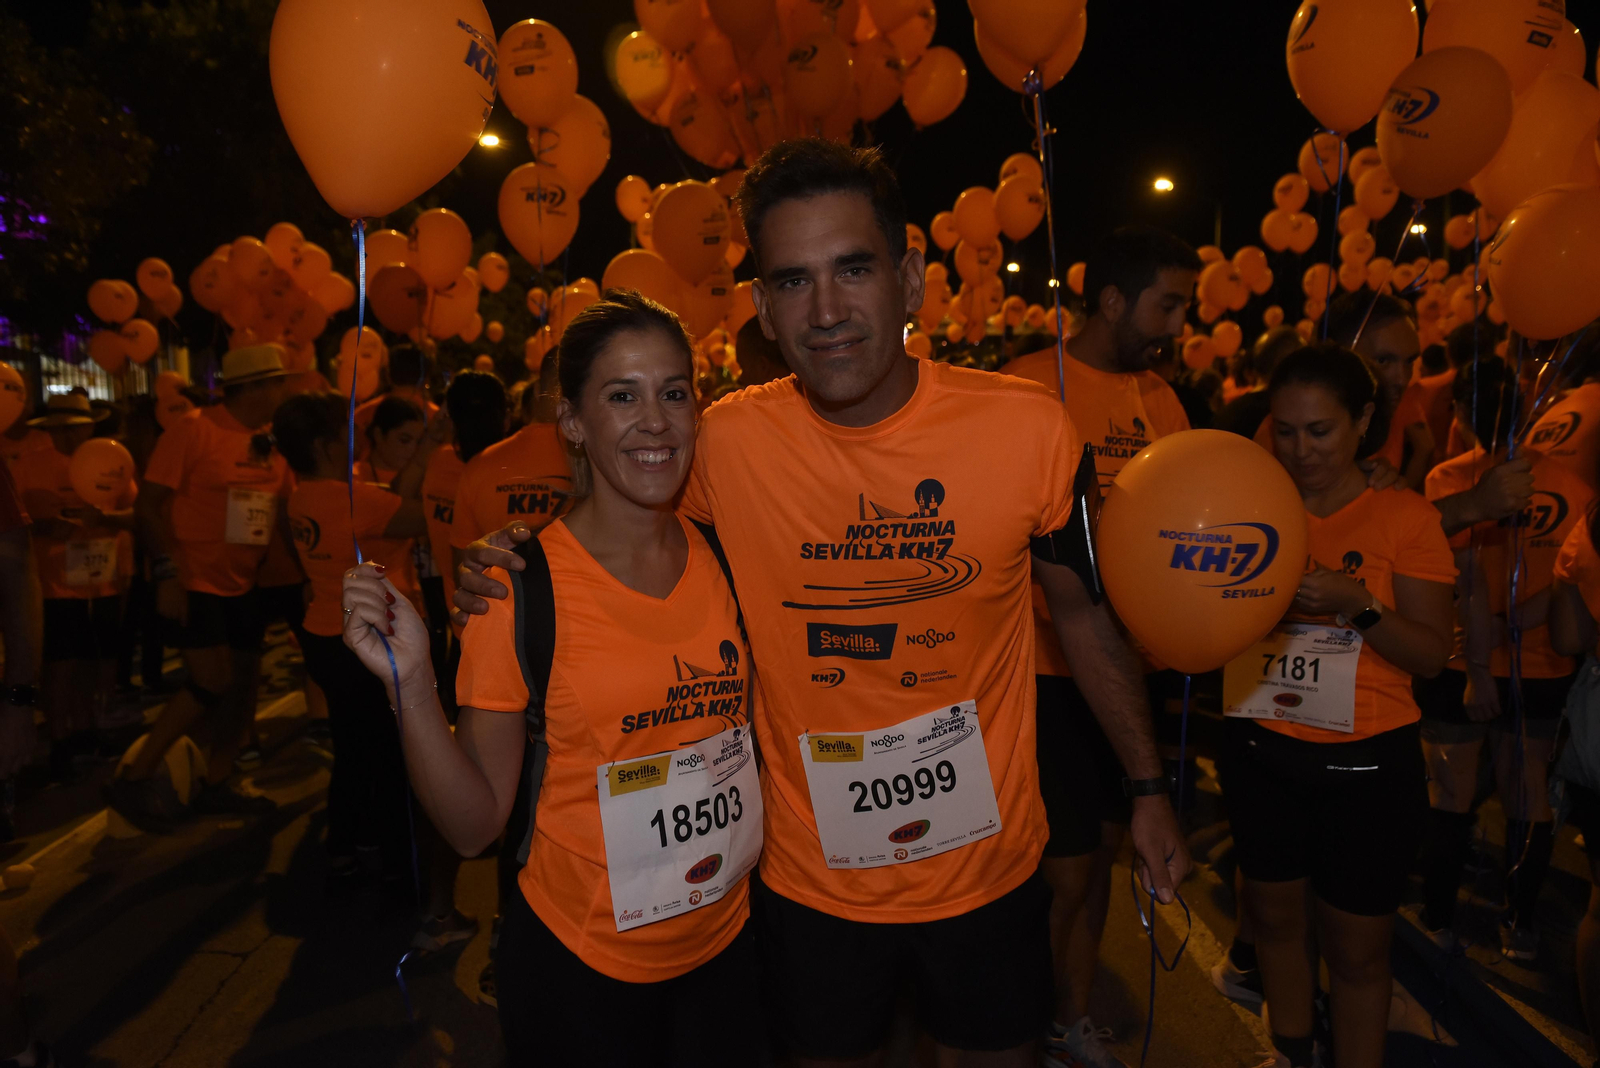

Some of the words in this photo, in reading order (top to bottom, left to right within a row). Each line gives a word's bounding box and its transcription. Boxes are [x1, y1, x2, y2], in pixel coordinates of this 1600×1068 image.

[1091, 446, 1128, 458] EVILLA
[496, 484, 549, 493] NOCTURNA
[845, 520, 956, 539] NOCTURNA
[1158, 529, 1233, 544] NOCTURNA
[800, 542, 895, 560] SEVILLA
[1221, 586, 1276, 599] SEVILLA
[920, 669, 948, 678] nationale
[1262, 653, 1320, 683] 7181
[920, 673, 958, 684] nederlanden
[666, 679, 744, 702] NOCTURNA
[621, 702, 705, 734] SEVILLA
[931, 716, 966, 733] NOCTURNA
[917, 730, 948, 745] SEVILLA
[720, 740, 743, 754] NOCTURNA
[712, 754, 732, 767] SEVILLA
[848, 760, 957, 813] 20999
[650, 785, 743, 848] 18503
[969, 822, 997, 836] Cruzcampo
